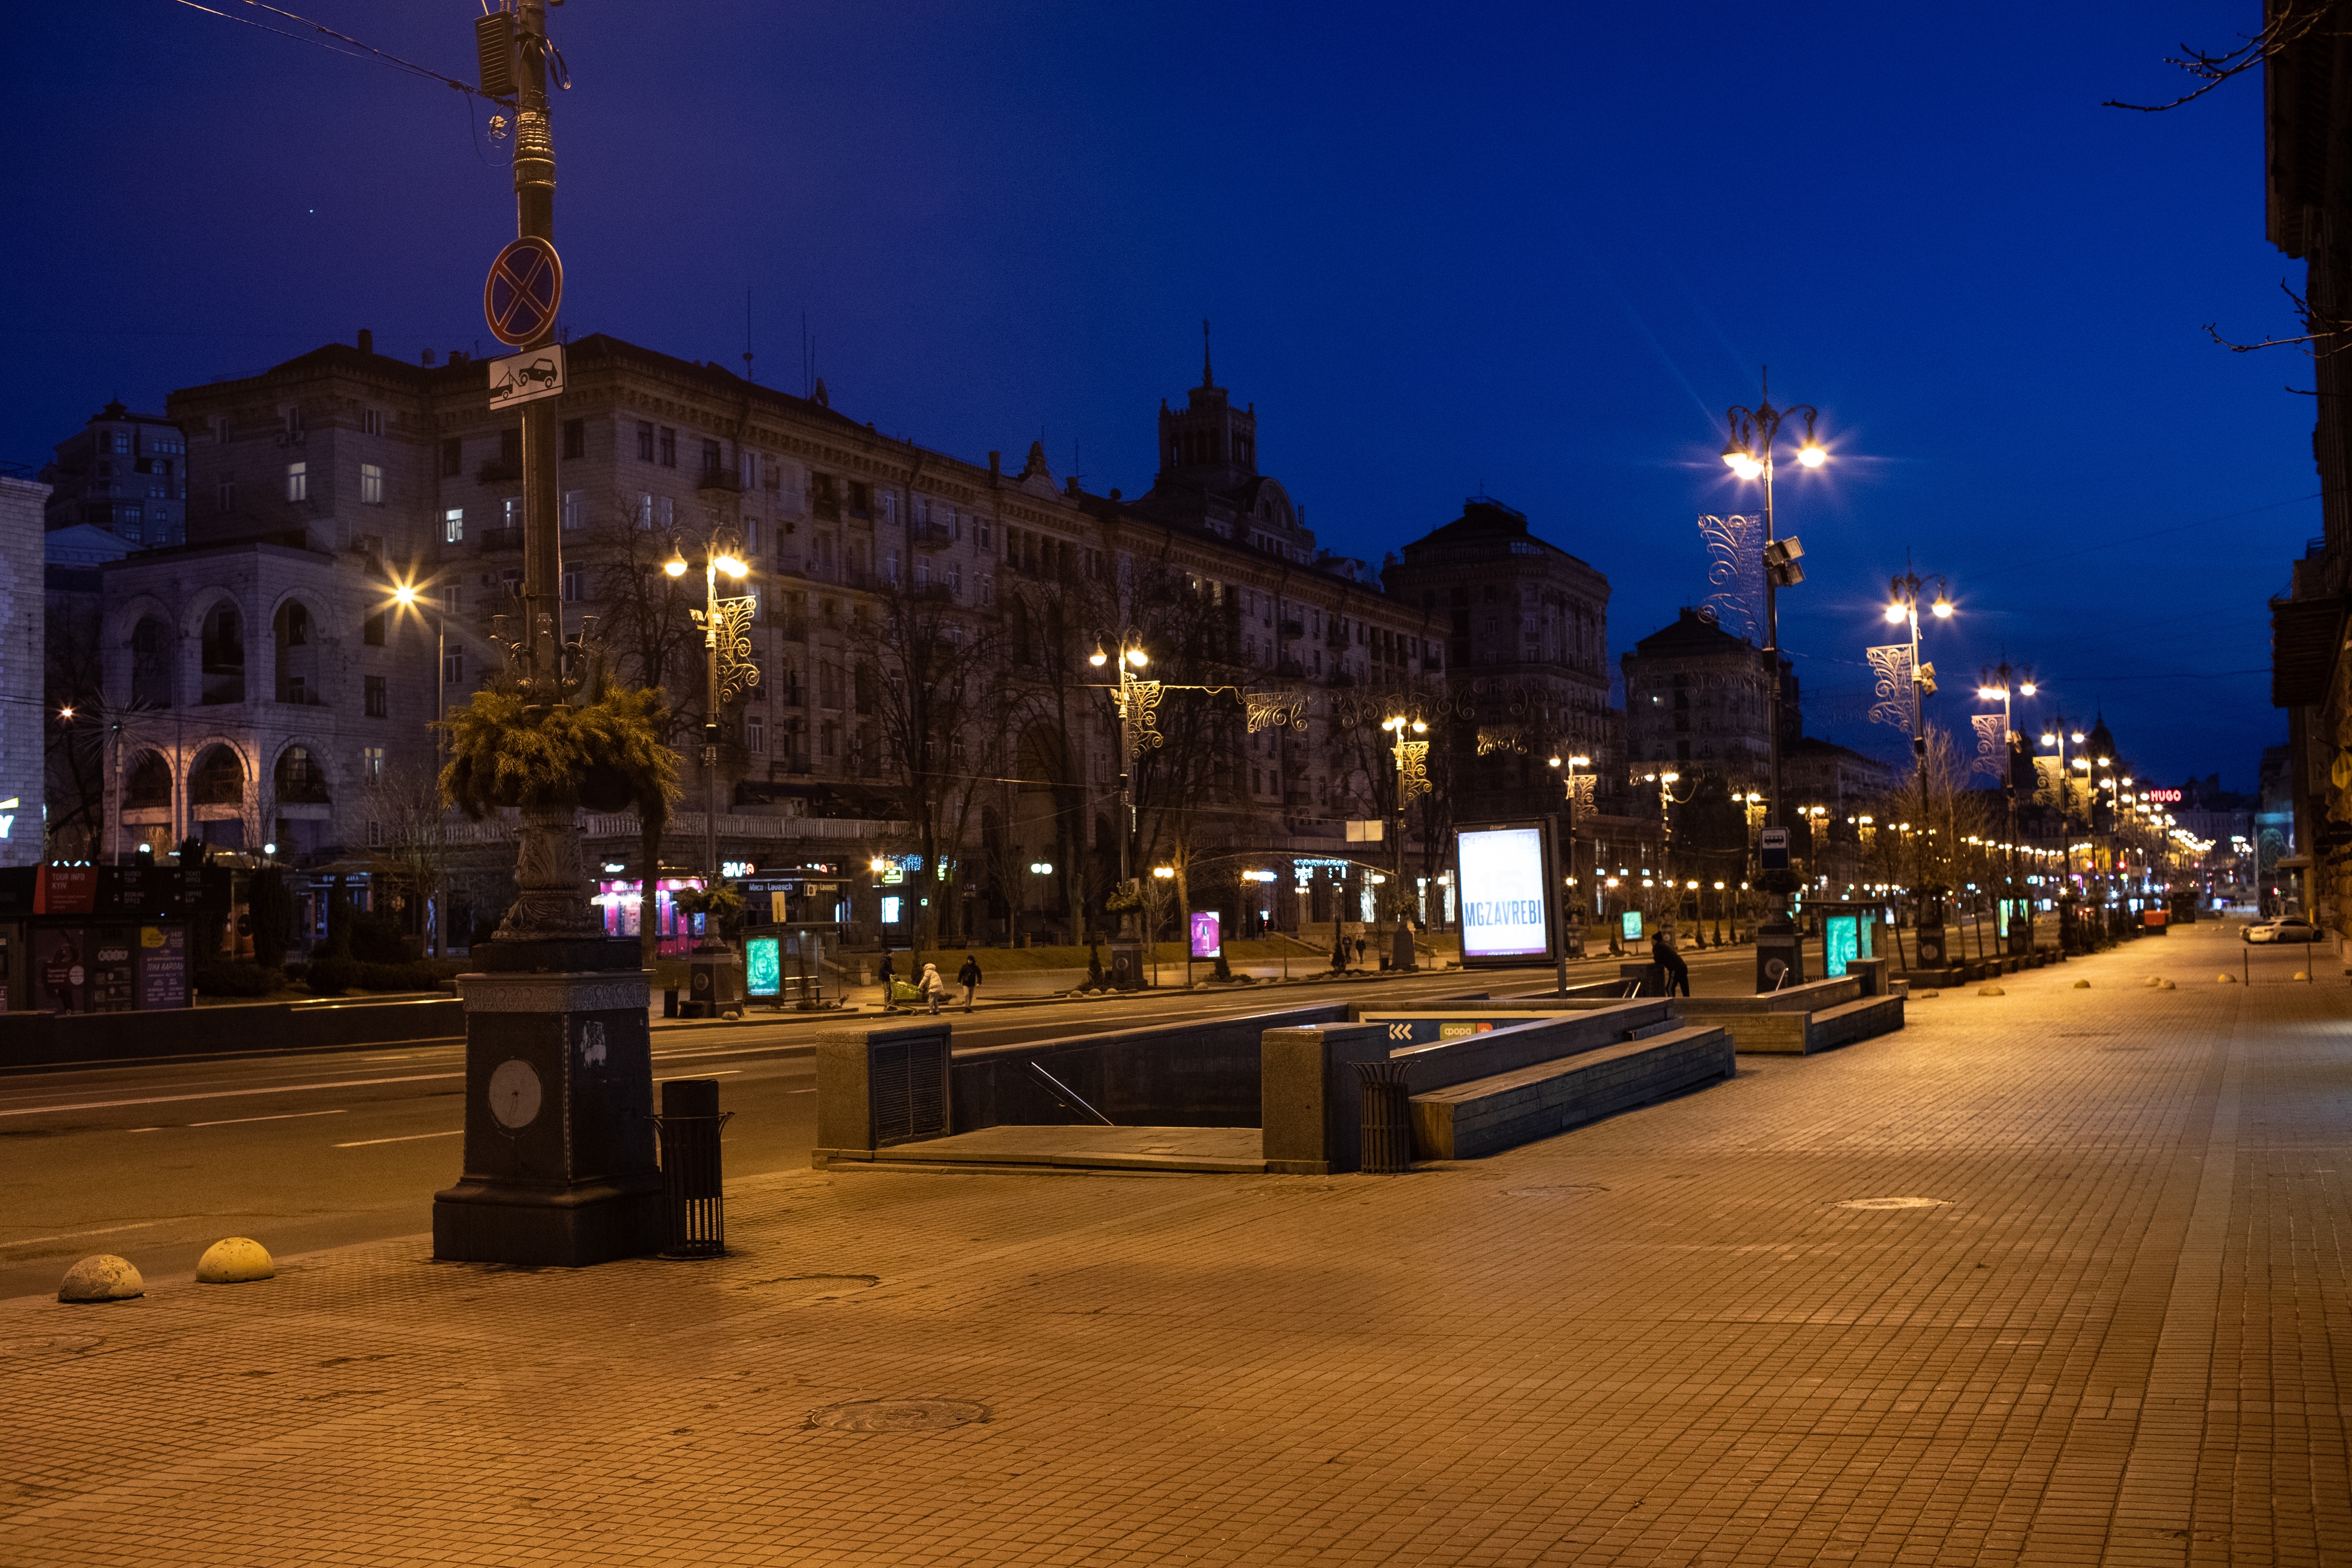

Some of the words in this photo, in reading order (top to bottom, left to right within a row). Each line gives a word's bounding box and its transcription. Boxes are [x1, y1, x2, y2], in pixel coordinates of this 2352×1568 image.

[2150, 790, 2181, 802] HUGO
[767, 882, 793, 891] Lavasch
[1465, 900, 1542, 927] MGZAVREBI
[1444, 1027, 1472, 1036] фора
